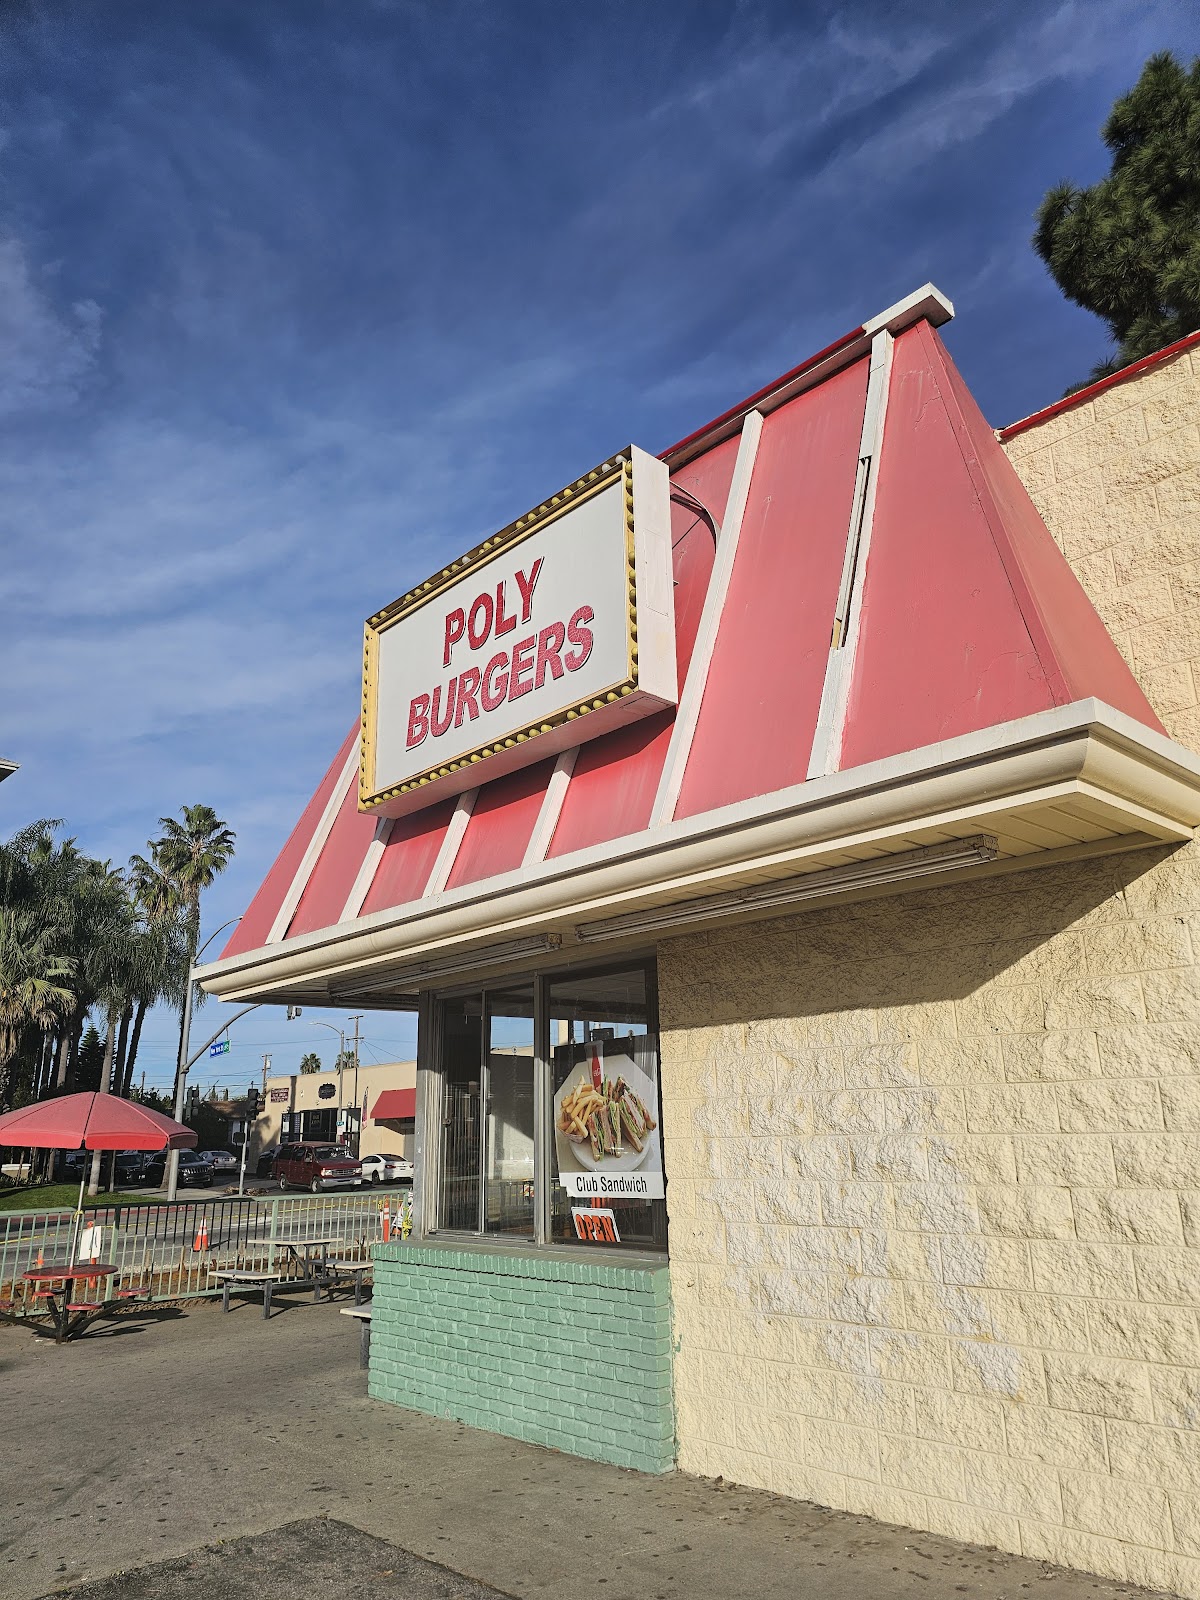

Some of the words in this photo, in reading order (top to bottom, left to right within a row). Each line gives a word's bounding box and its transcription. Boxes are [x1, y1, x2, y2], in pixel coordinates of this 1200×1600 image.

[442, 556, 544, 668] POLY
[406, 606, 594, 752] BURGERS
[576, 1176, 597, 1192] Club
[600, 1176, 648, 1193] Sandwich
[575, 1214, 617, 1242] OPEN
